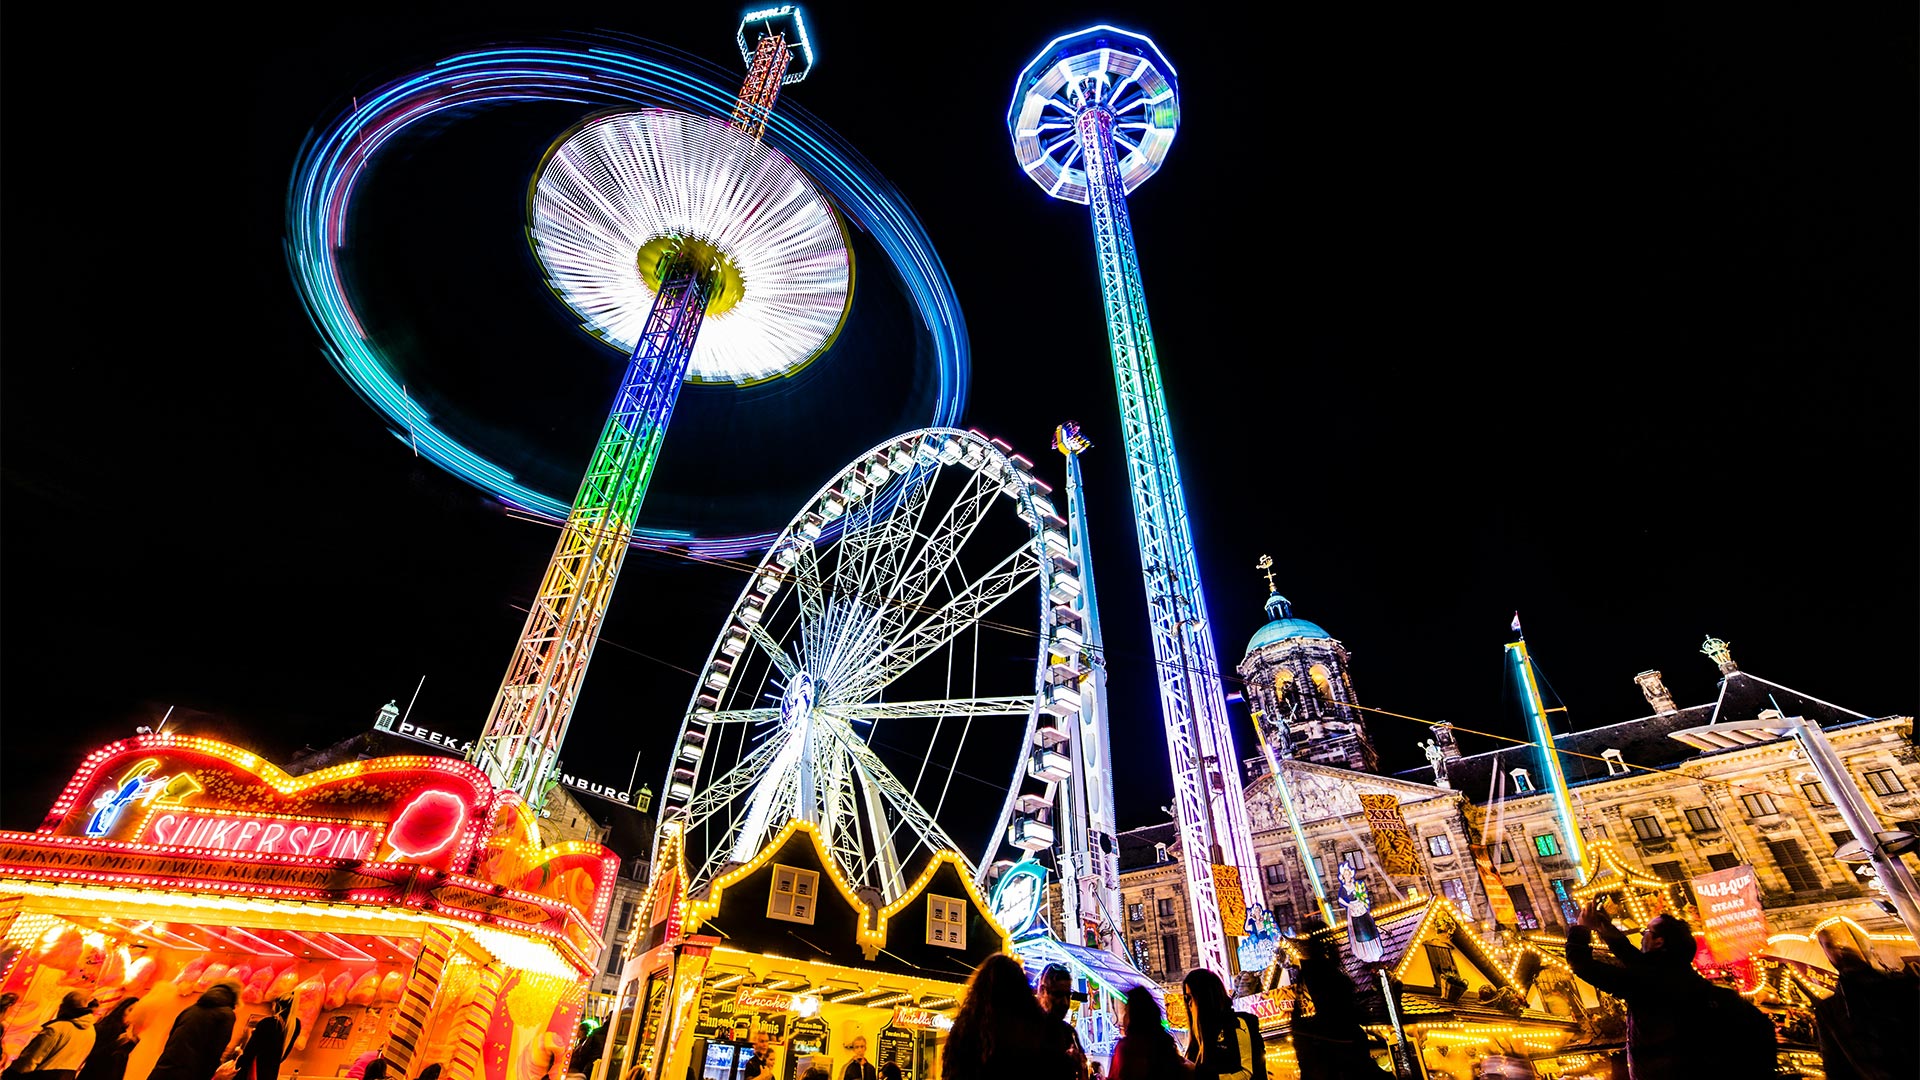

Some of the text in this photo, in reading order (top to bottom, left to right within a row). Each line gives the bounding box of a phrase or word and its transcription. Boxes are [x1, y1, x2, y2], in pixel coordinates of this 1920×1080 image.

[398, 722, 458, 750] PEEK
[1368, 809, 1400, 820] XXL
[1372, 821, 1404, 831] FRITES
[154, 814, 370, 860] SUIKERSPIN
[101, 853, 148, 870] MET
[157, 859, 218, 877] TWEE
[223, 865, 330, 885] KLEUREN
[1711, 898, 1745, 913] STEAKS
[737, 989, 792, 1009] Pancakes
[1251, 999, 1280, 1018] XXL
[895, 1011, 932, 1027] Nutella
